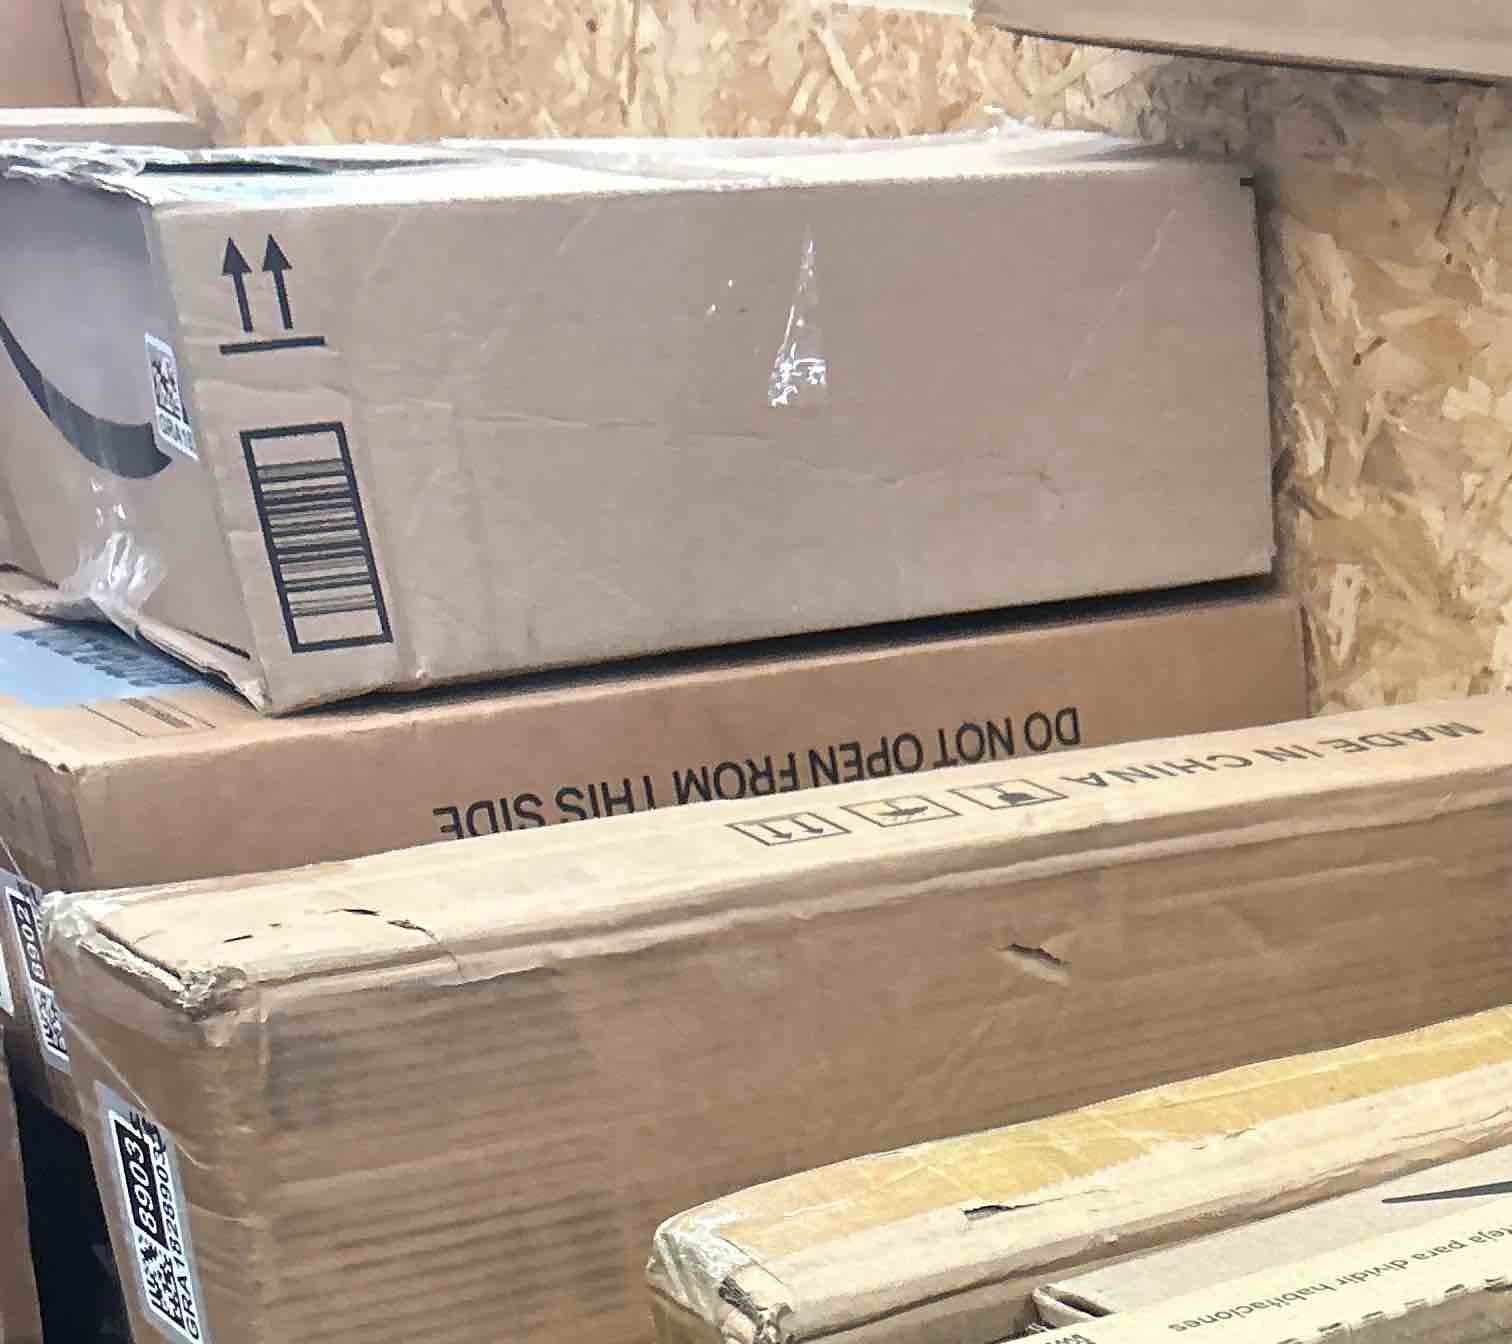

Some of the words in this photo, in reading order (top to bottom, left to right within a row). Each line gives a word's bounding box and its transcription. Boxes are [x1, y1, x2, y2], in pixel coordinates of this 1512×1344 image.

[933, 716, 1015, 770] NOT
[1024, 706, 1082, 753] DO
[1254, 742, 1325, 763] IN
[1320, 720, 1485, 755] MADE
[671, 750, 800, 805] FROM
[808, 731, 925, 788] OPEN
[1062, 752, 1254, 789] CHINA
[432, 792, 547, 840] SIDE
[554, 774, 658, 824] THIS
[124, 1135, 159, 1235] 8903
[1336, 1257, 1410, 1285] dividir
[1411, 1239, 1467, 1262] para
[1168, 1281, 1337, 1334] habitaciones
